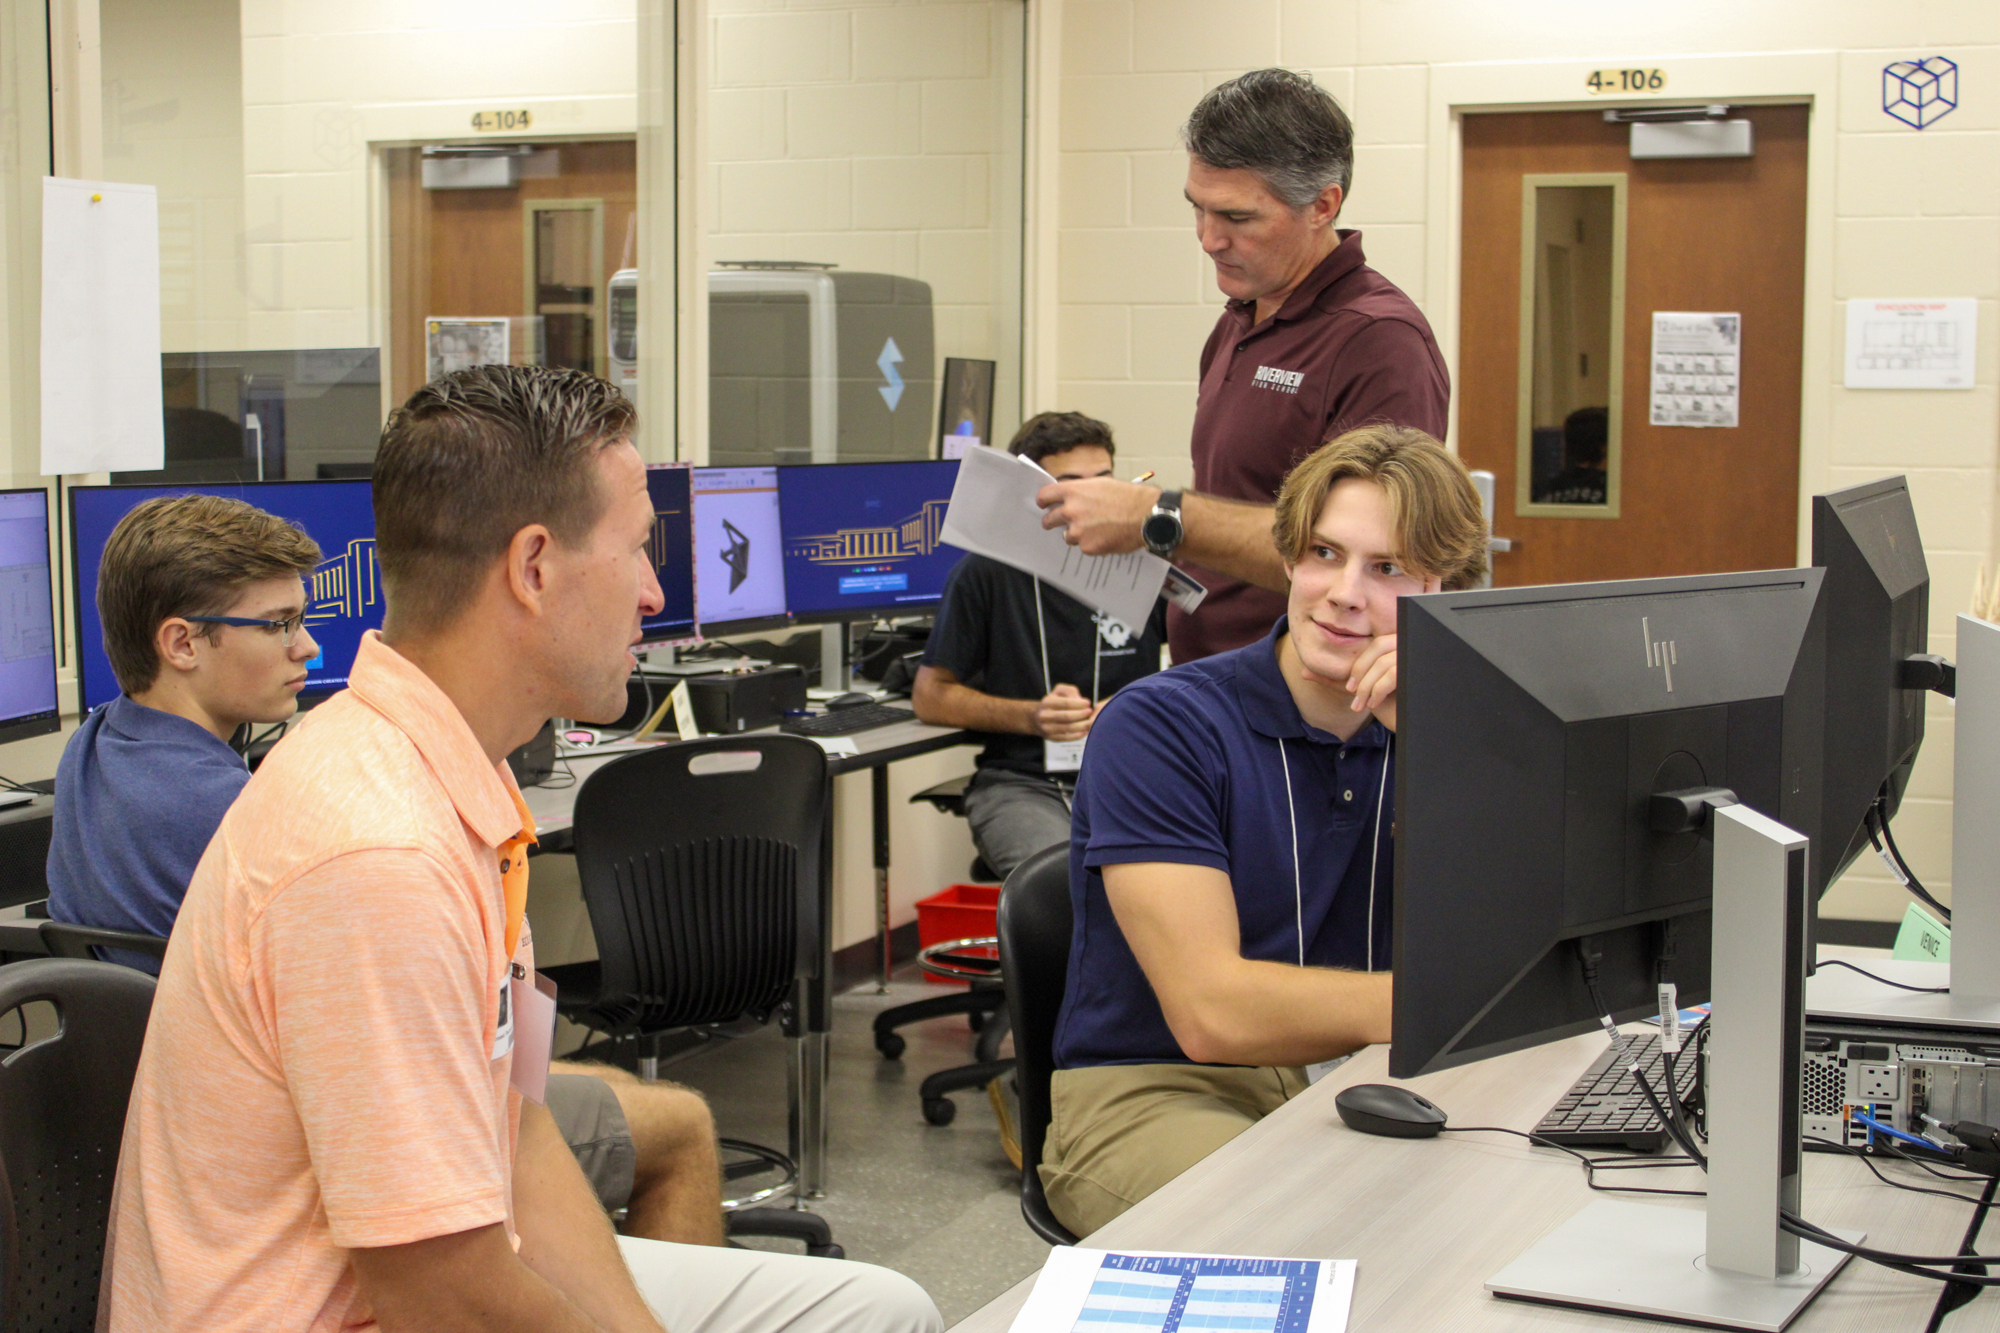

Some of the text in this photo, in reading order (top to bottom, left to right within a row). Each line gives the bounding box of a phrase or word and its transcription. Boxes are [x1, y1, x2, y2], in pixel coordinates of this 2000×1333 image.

[1587, 69, 1663, 91] 4-106
[471, 110, 529, 130] 4-104
[1254, 365, 1304, 387] RIVERVIEW
[1921, 930, 1940, 957] VENICE
